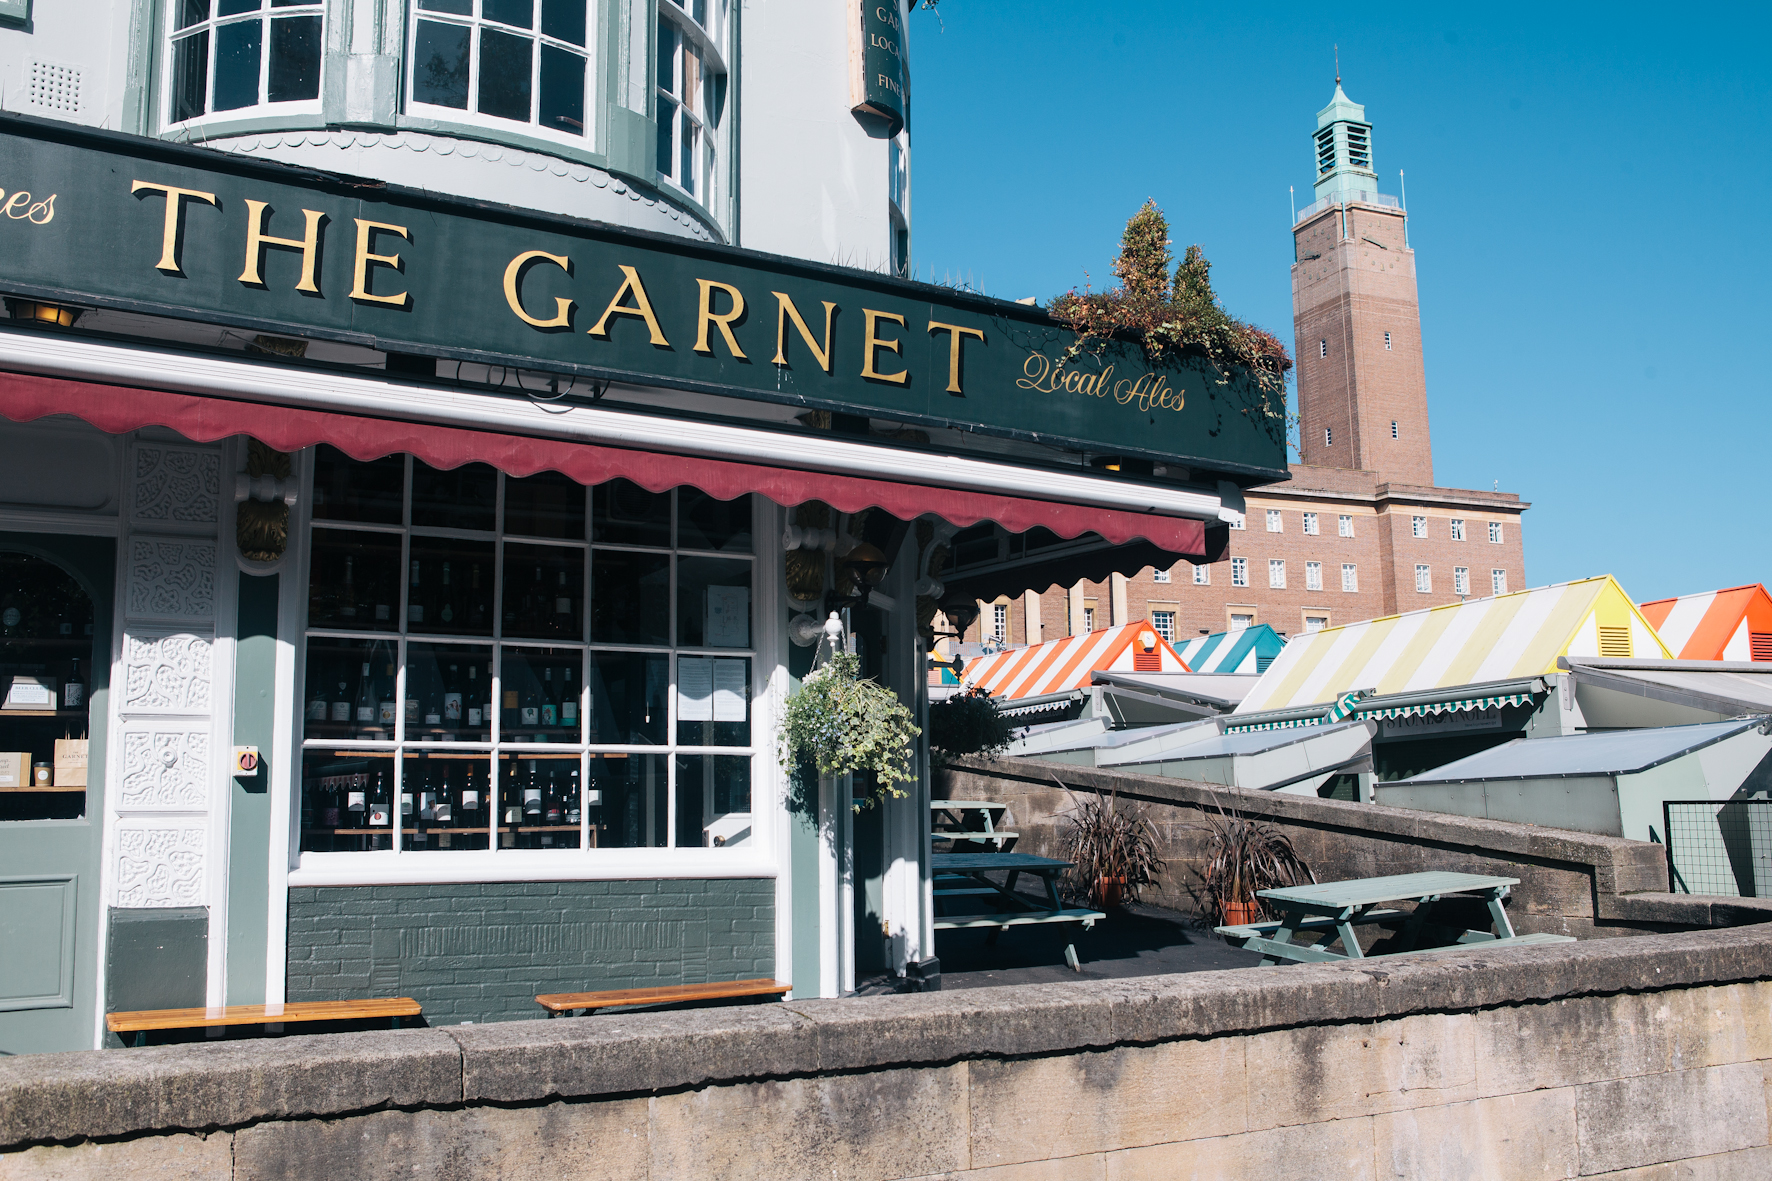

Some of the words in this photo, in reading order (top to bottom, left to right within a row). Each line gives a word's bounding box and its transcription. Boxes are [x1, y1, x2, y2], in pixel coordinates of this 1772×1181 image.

[0, 187, 57, 224] es
[131, 179, 410, 308] THE
[503, 249, 987, 394] GARNET
[1016, 350, 1115, 398] Local
[1114, 372, 1186, 412] Ales
